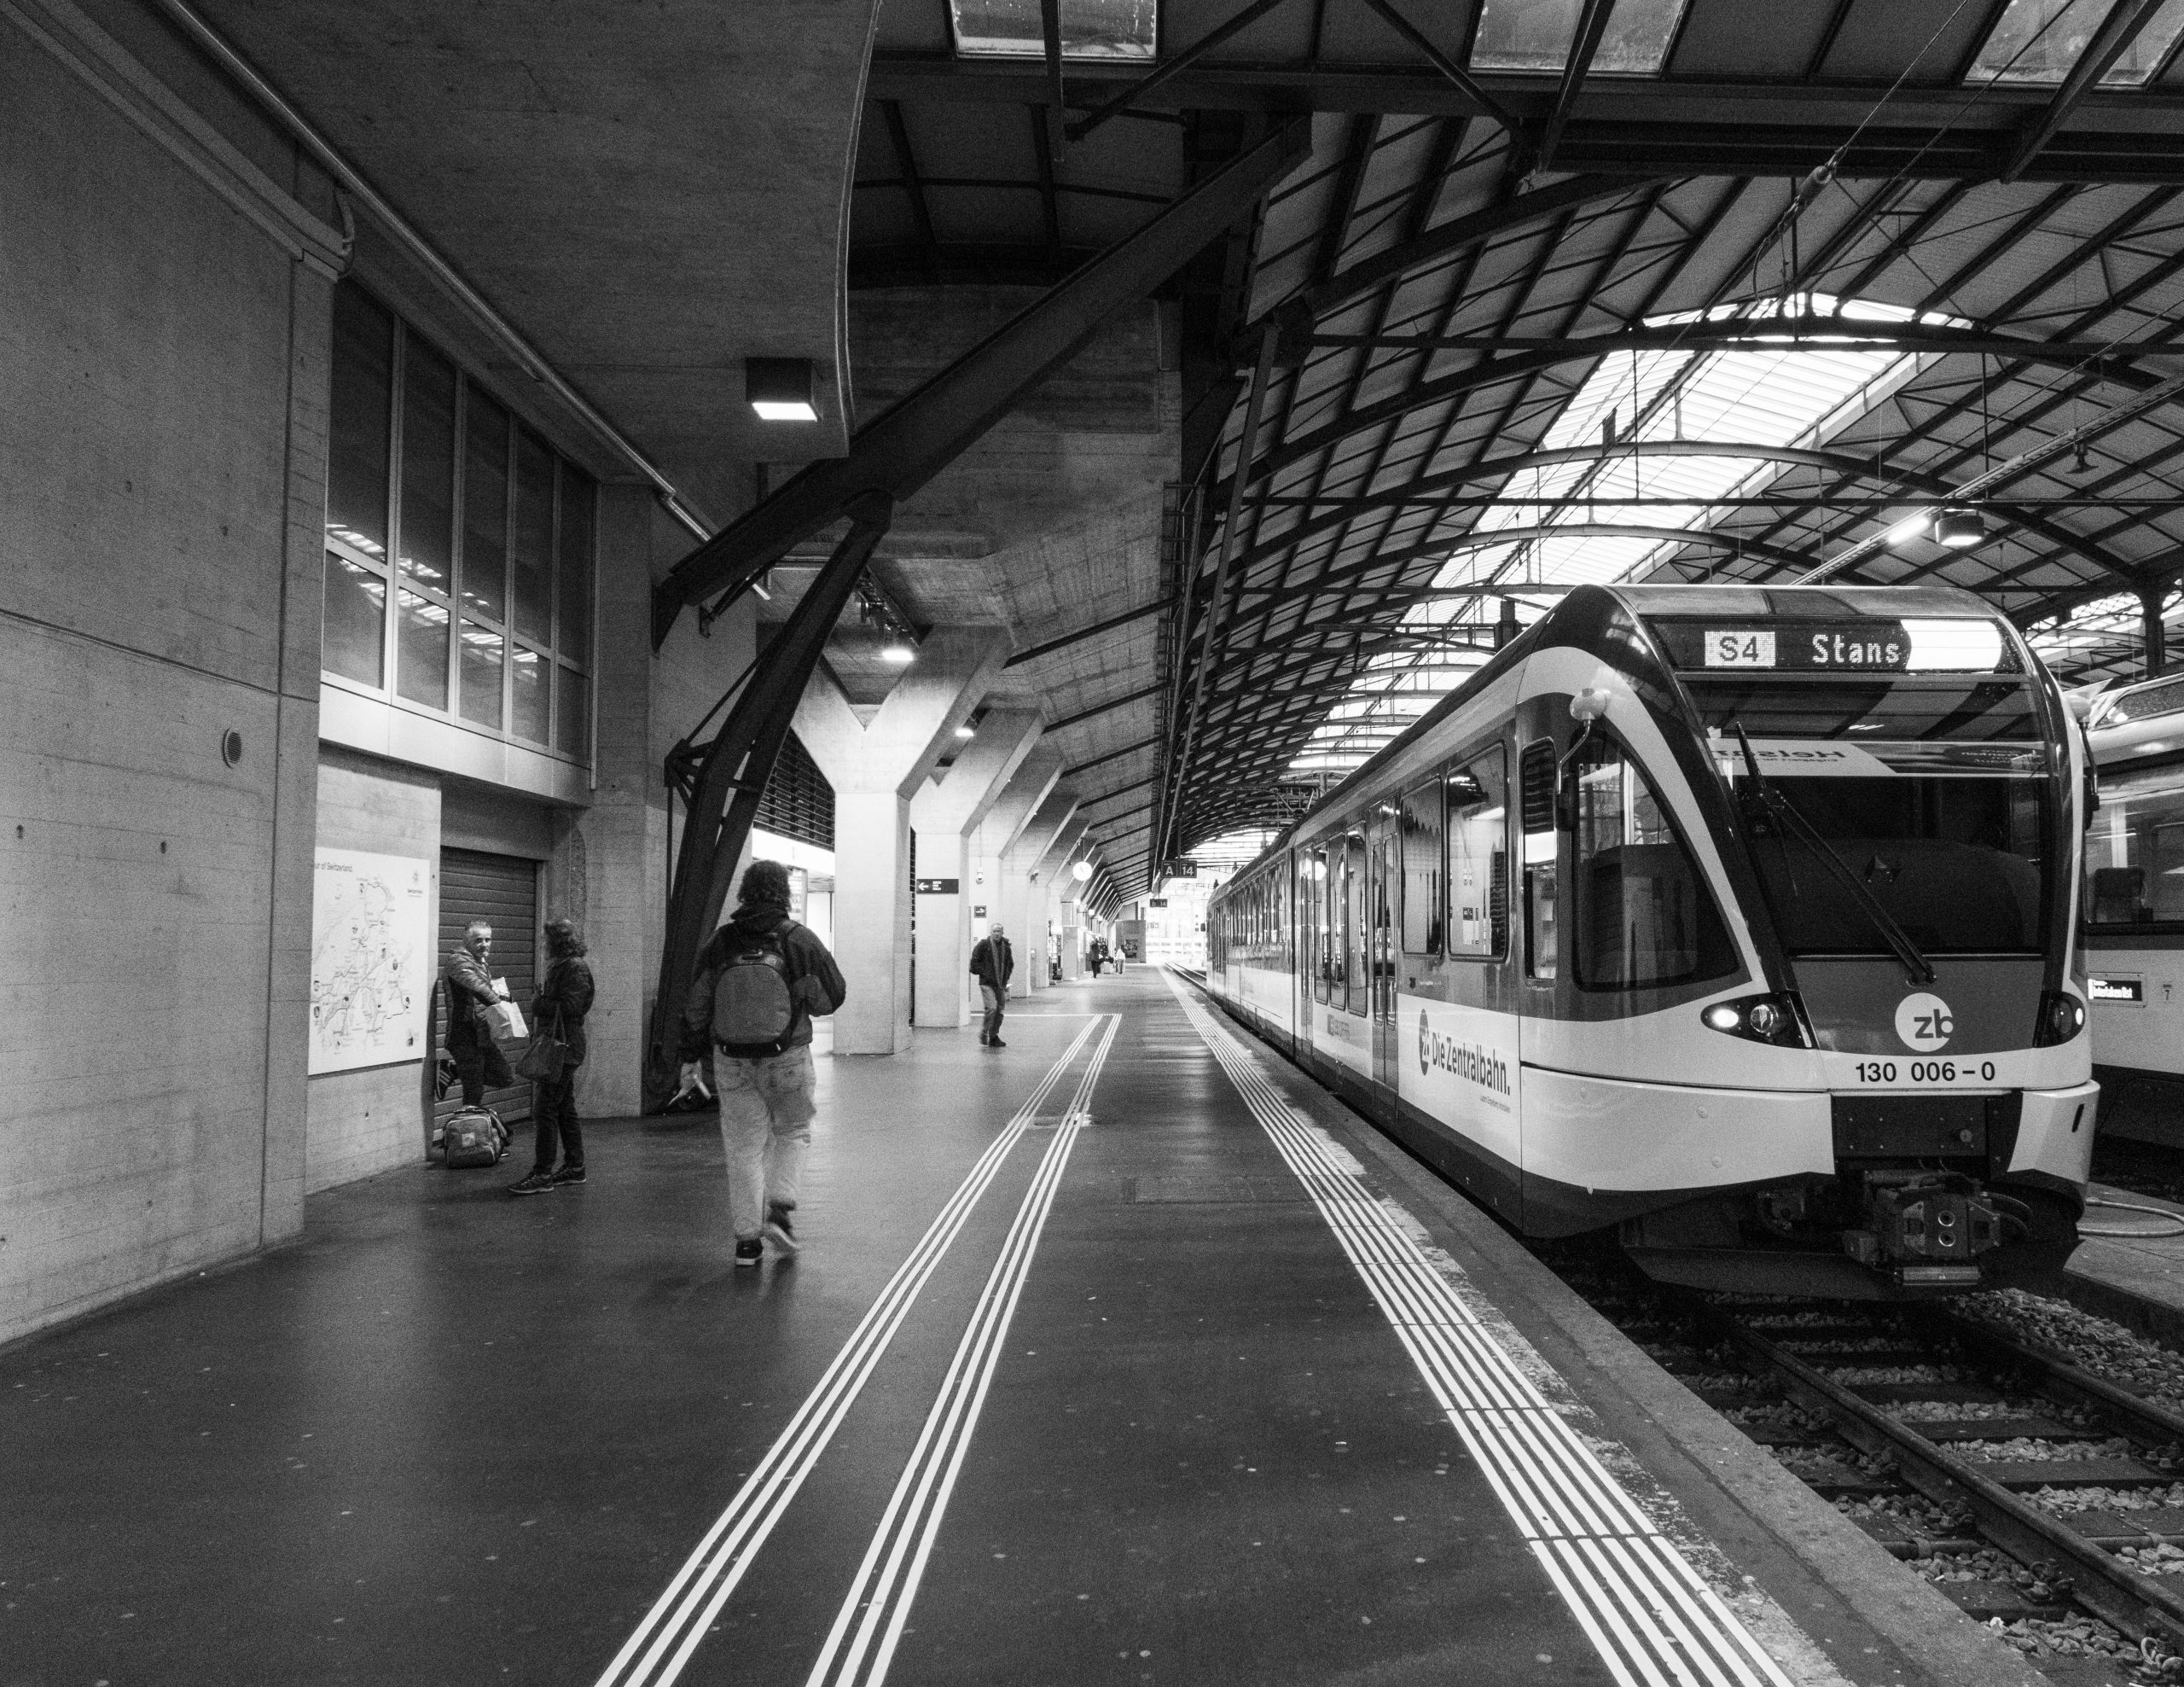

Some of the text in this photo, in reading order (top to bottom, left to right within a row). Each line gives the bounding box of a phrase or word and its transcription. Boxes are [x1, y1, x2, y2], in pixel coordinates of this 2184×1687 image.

[1720, 634, 1900, 663] S4 Stans
[1165, 865, 1194, 875] A 14
[1914, 1009, 1957, 1039] zb
[1432, 1032, 1511, 1096] Die Zentralbahn.
[1856, 1062, 1897, 1082] 130
